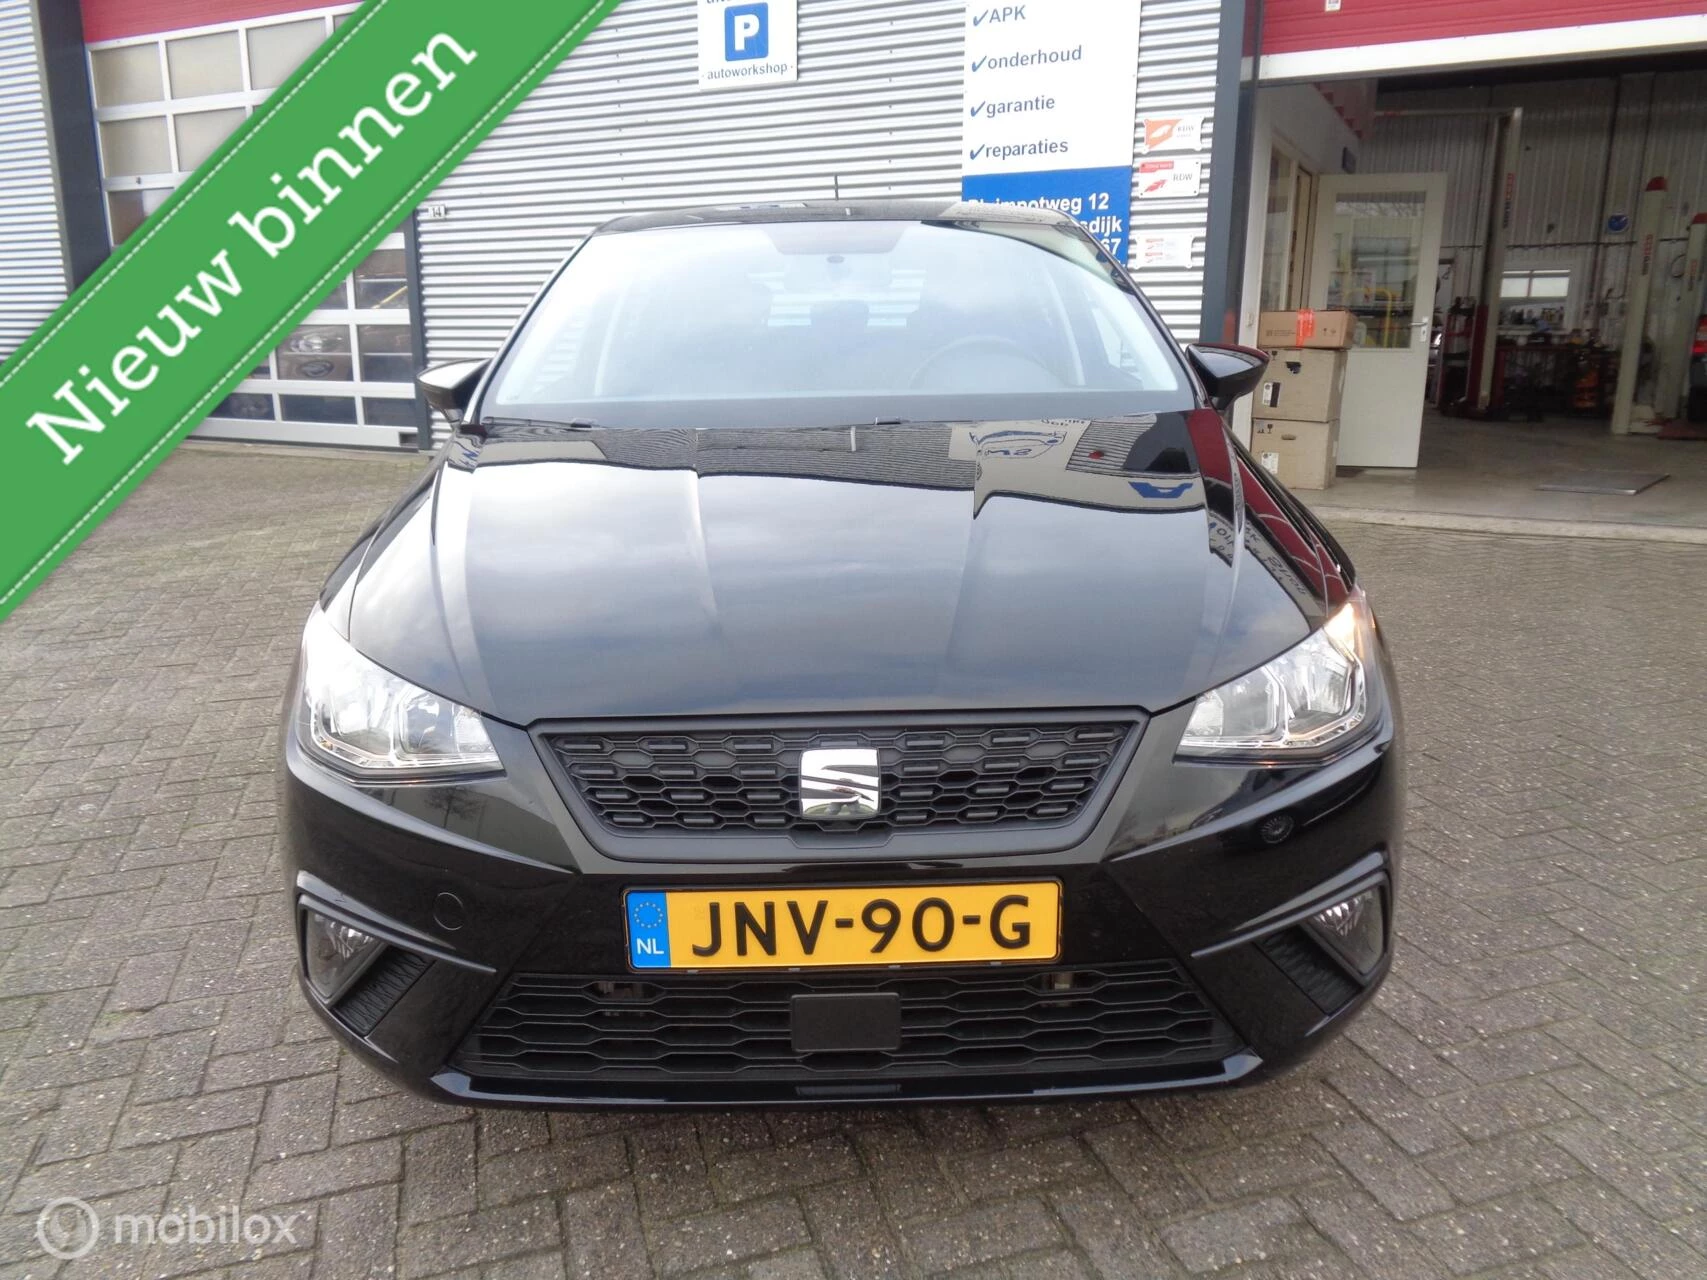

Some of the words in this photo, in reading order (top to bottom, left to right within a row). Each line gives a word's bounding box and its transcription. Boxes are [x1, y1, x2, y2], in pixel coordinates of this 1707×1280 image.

[989, 5, 1026, 23] APK
[734, 14, 760, 51] P
[987, 44, 1082, 70] onderhoud
[707, 62, 788, 80] autoworkshop
[986, 95, 1055, 119] garantie
[985, 138, 1069, 161] reparaties
[1088, 192, 1110, 210] 12
[691, 895, 1032, 958] JNV-90-G
[636, 938, 664, 955] NL
